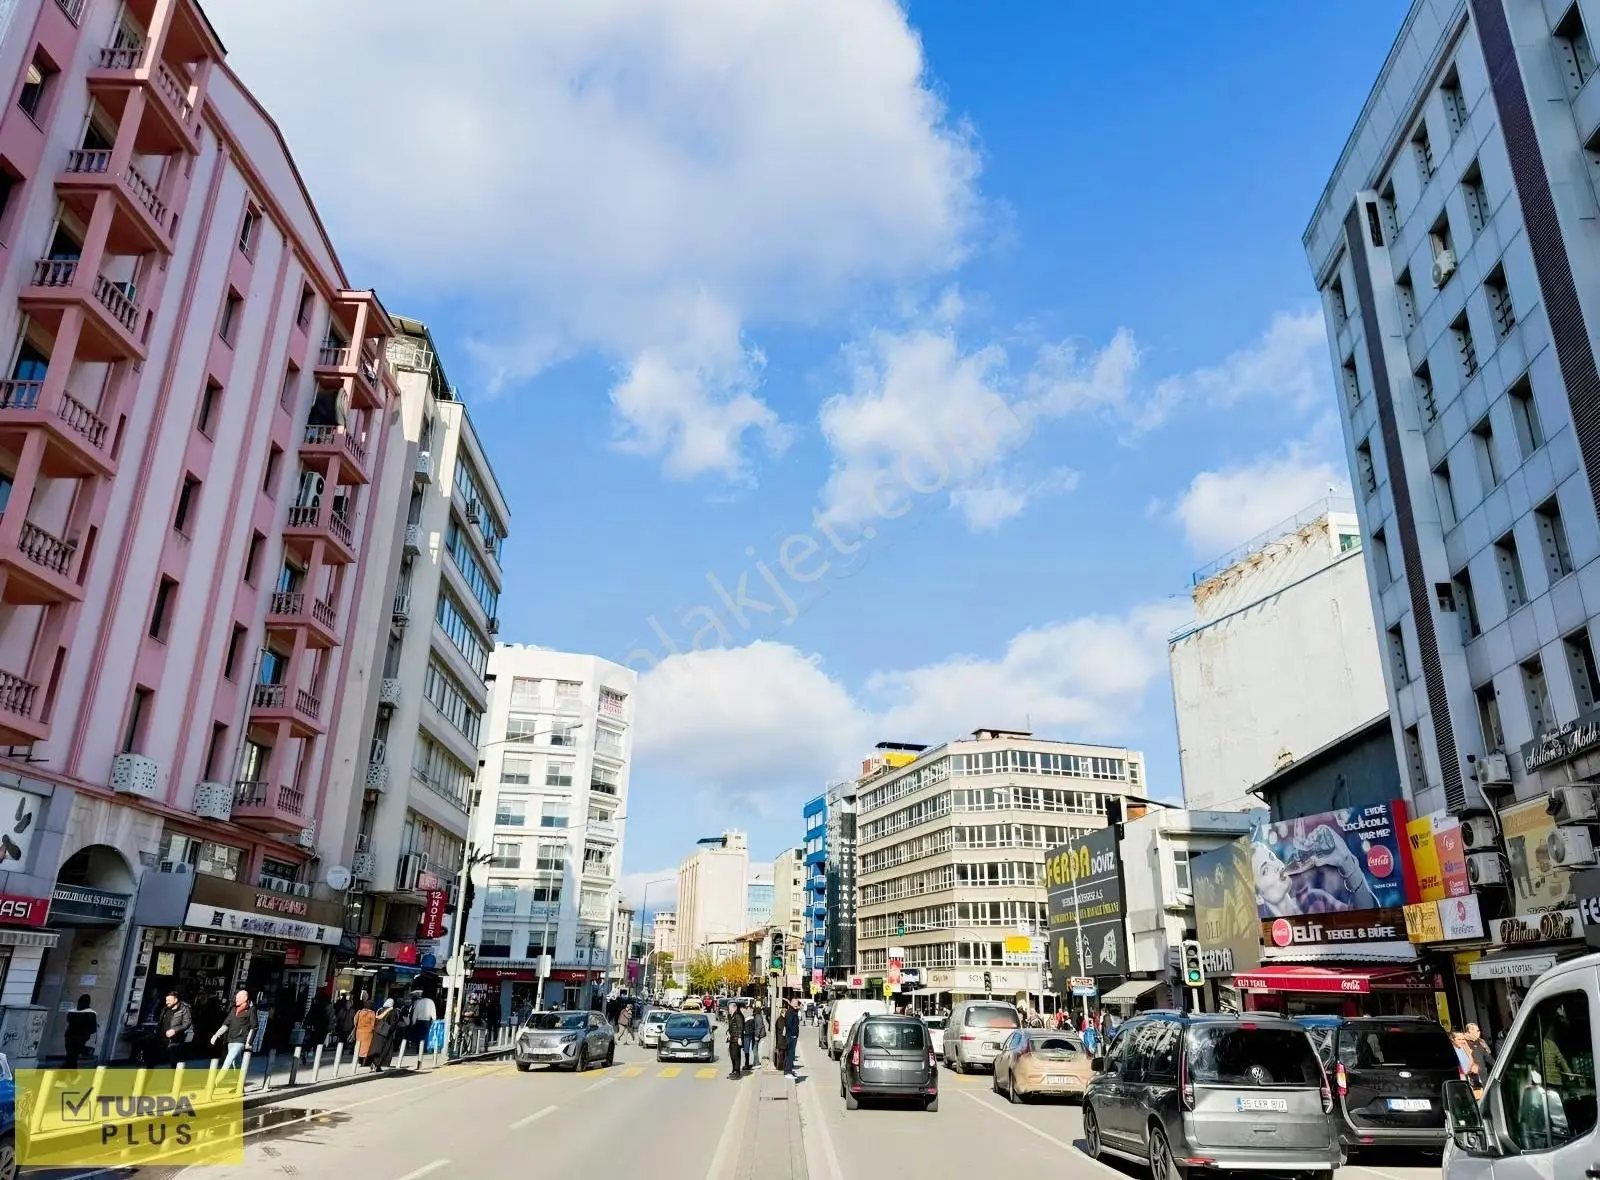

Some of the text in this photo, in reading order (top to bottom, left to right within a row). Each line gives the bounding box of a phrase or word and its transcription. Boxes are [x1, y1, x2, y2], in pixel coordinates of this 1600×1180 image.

[1043, 845, 1115, 888] FERDA DÖVİZ
[427, 899, 439, 937] NOTER
[1292, 921, 1396, 943] ELİT TEKEL & BÜFE
